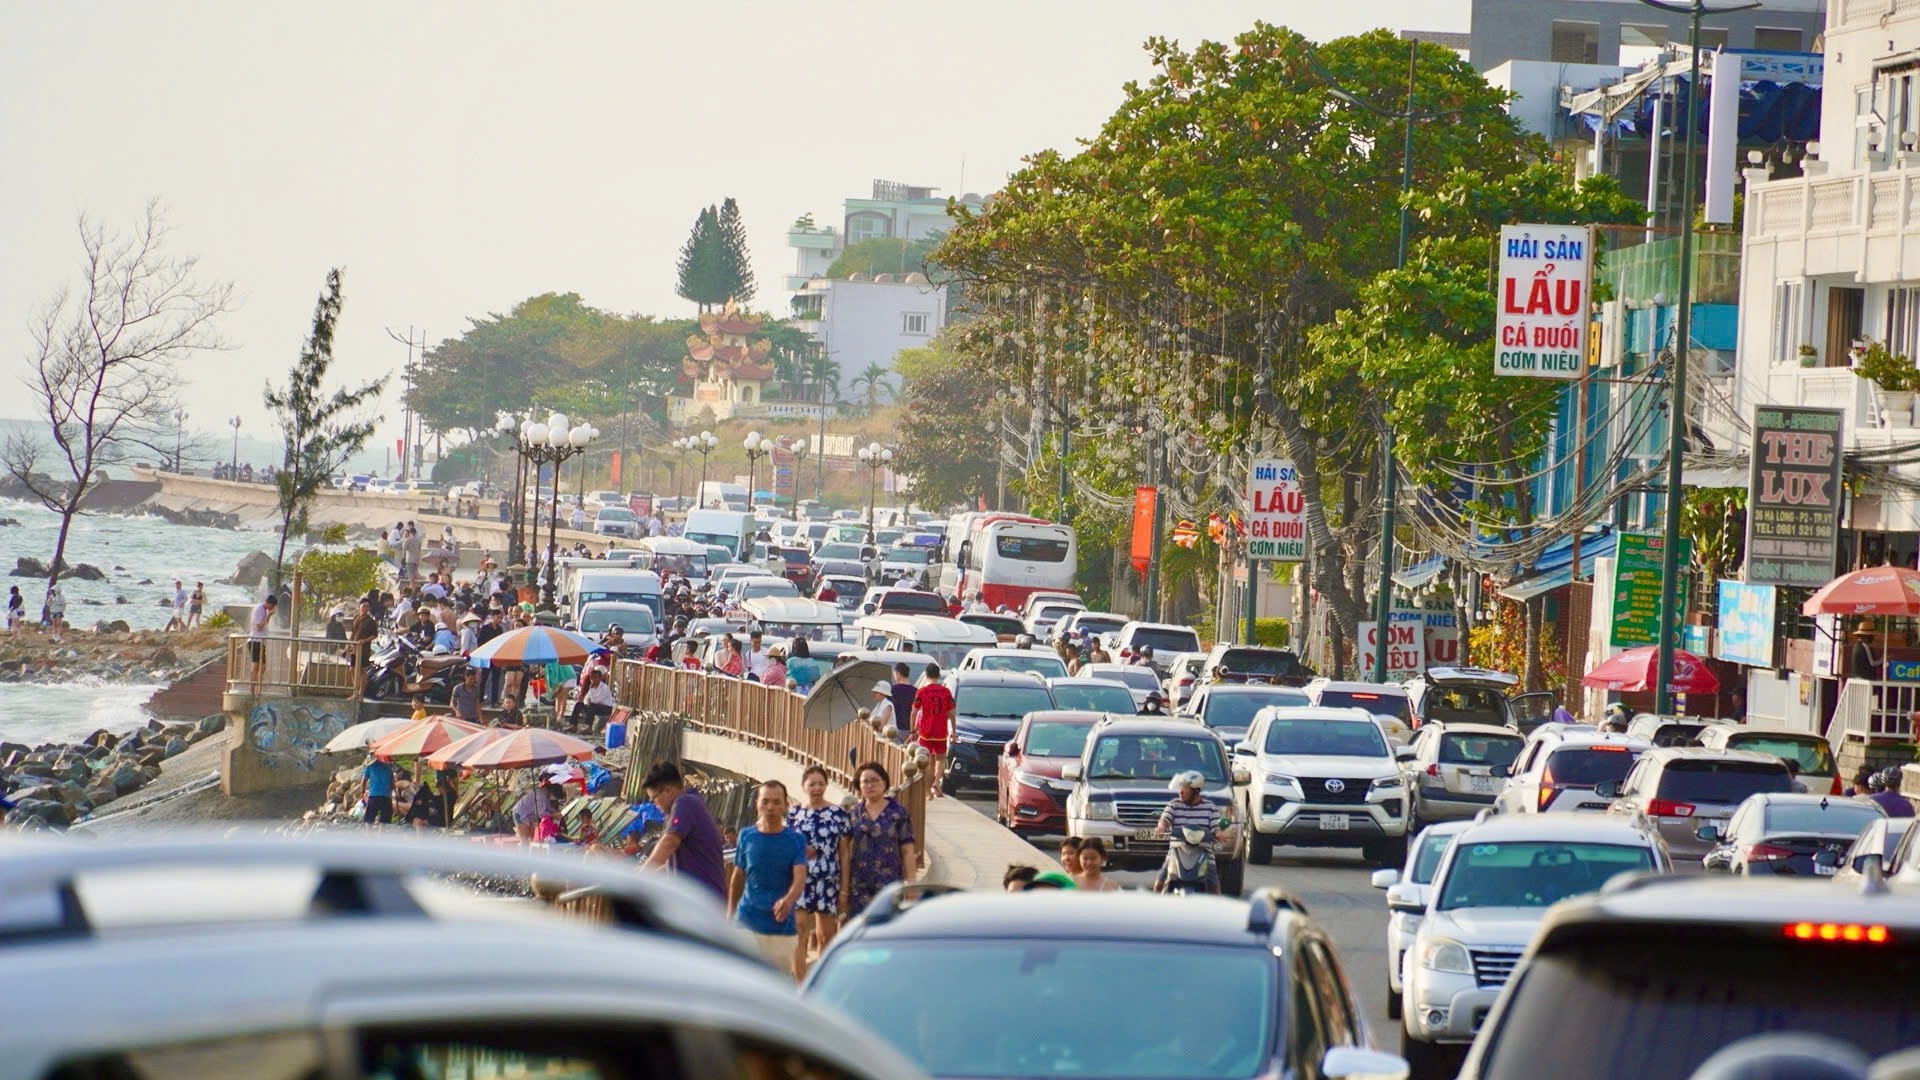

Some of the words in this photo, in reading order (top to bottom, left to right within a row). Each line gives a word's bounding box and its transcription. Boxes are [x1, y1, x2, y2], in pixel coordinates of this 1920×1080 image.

[1507, 233, 1538, 258] HẢI
[1544, 234, 1582, 260] SẢN
[1505, 263, 1581, 316] LẨU
[1502, 321, 1527, 347] CÁ
[1534, 319, 1579, 349] ĐUỐI
[1500, 351, 1536, 369] CƠM
[1541, 350, 1579, 371] NIÊU
[1761, 430, 1834, 467] THE
[1256, 463, 1277, 480] HẢI
[1280, 464, 1298, 480] SẢ
[1254, 482, 1304, 514] LẨU
[1760, 470, 1831, 505] LUX
[1251, 517, 1268, 538] CÁ
[1273, 516, 1303, 539] ĐUỐI
[1250, 541, 1274, 554] CƠM
[1277, 540, 1303, 556] NIÊU
[1364, 646, 1419, 671] NÊU
[1895, 664, 1920, 678] Caf
